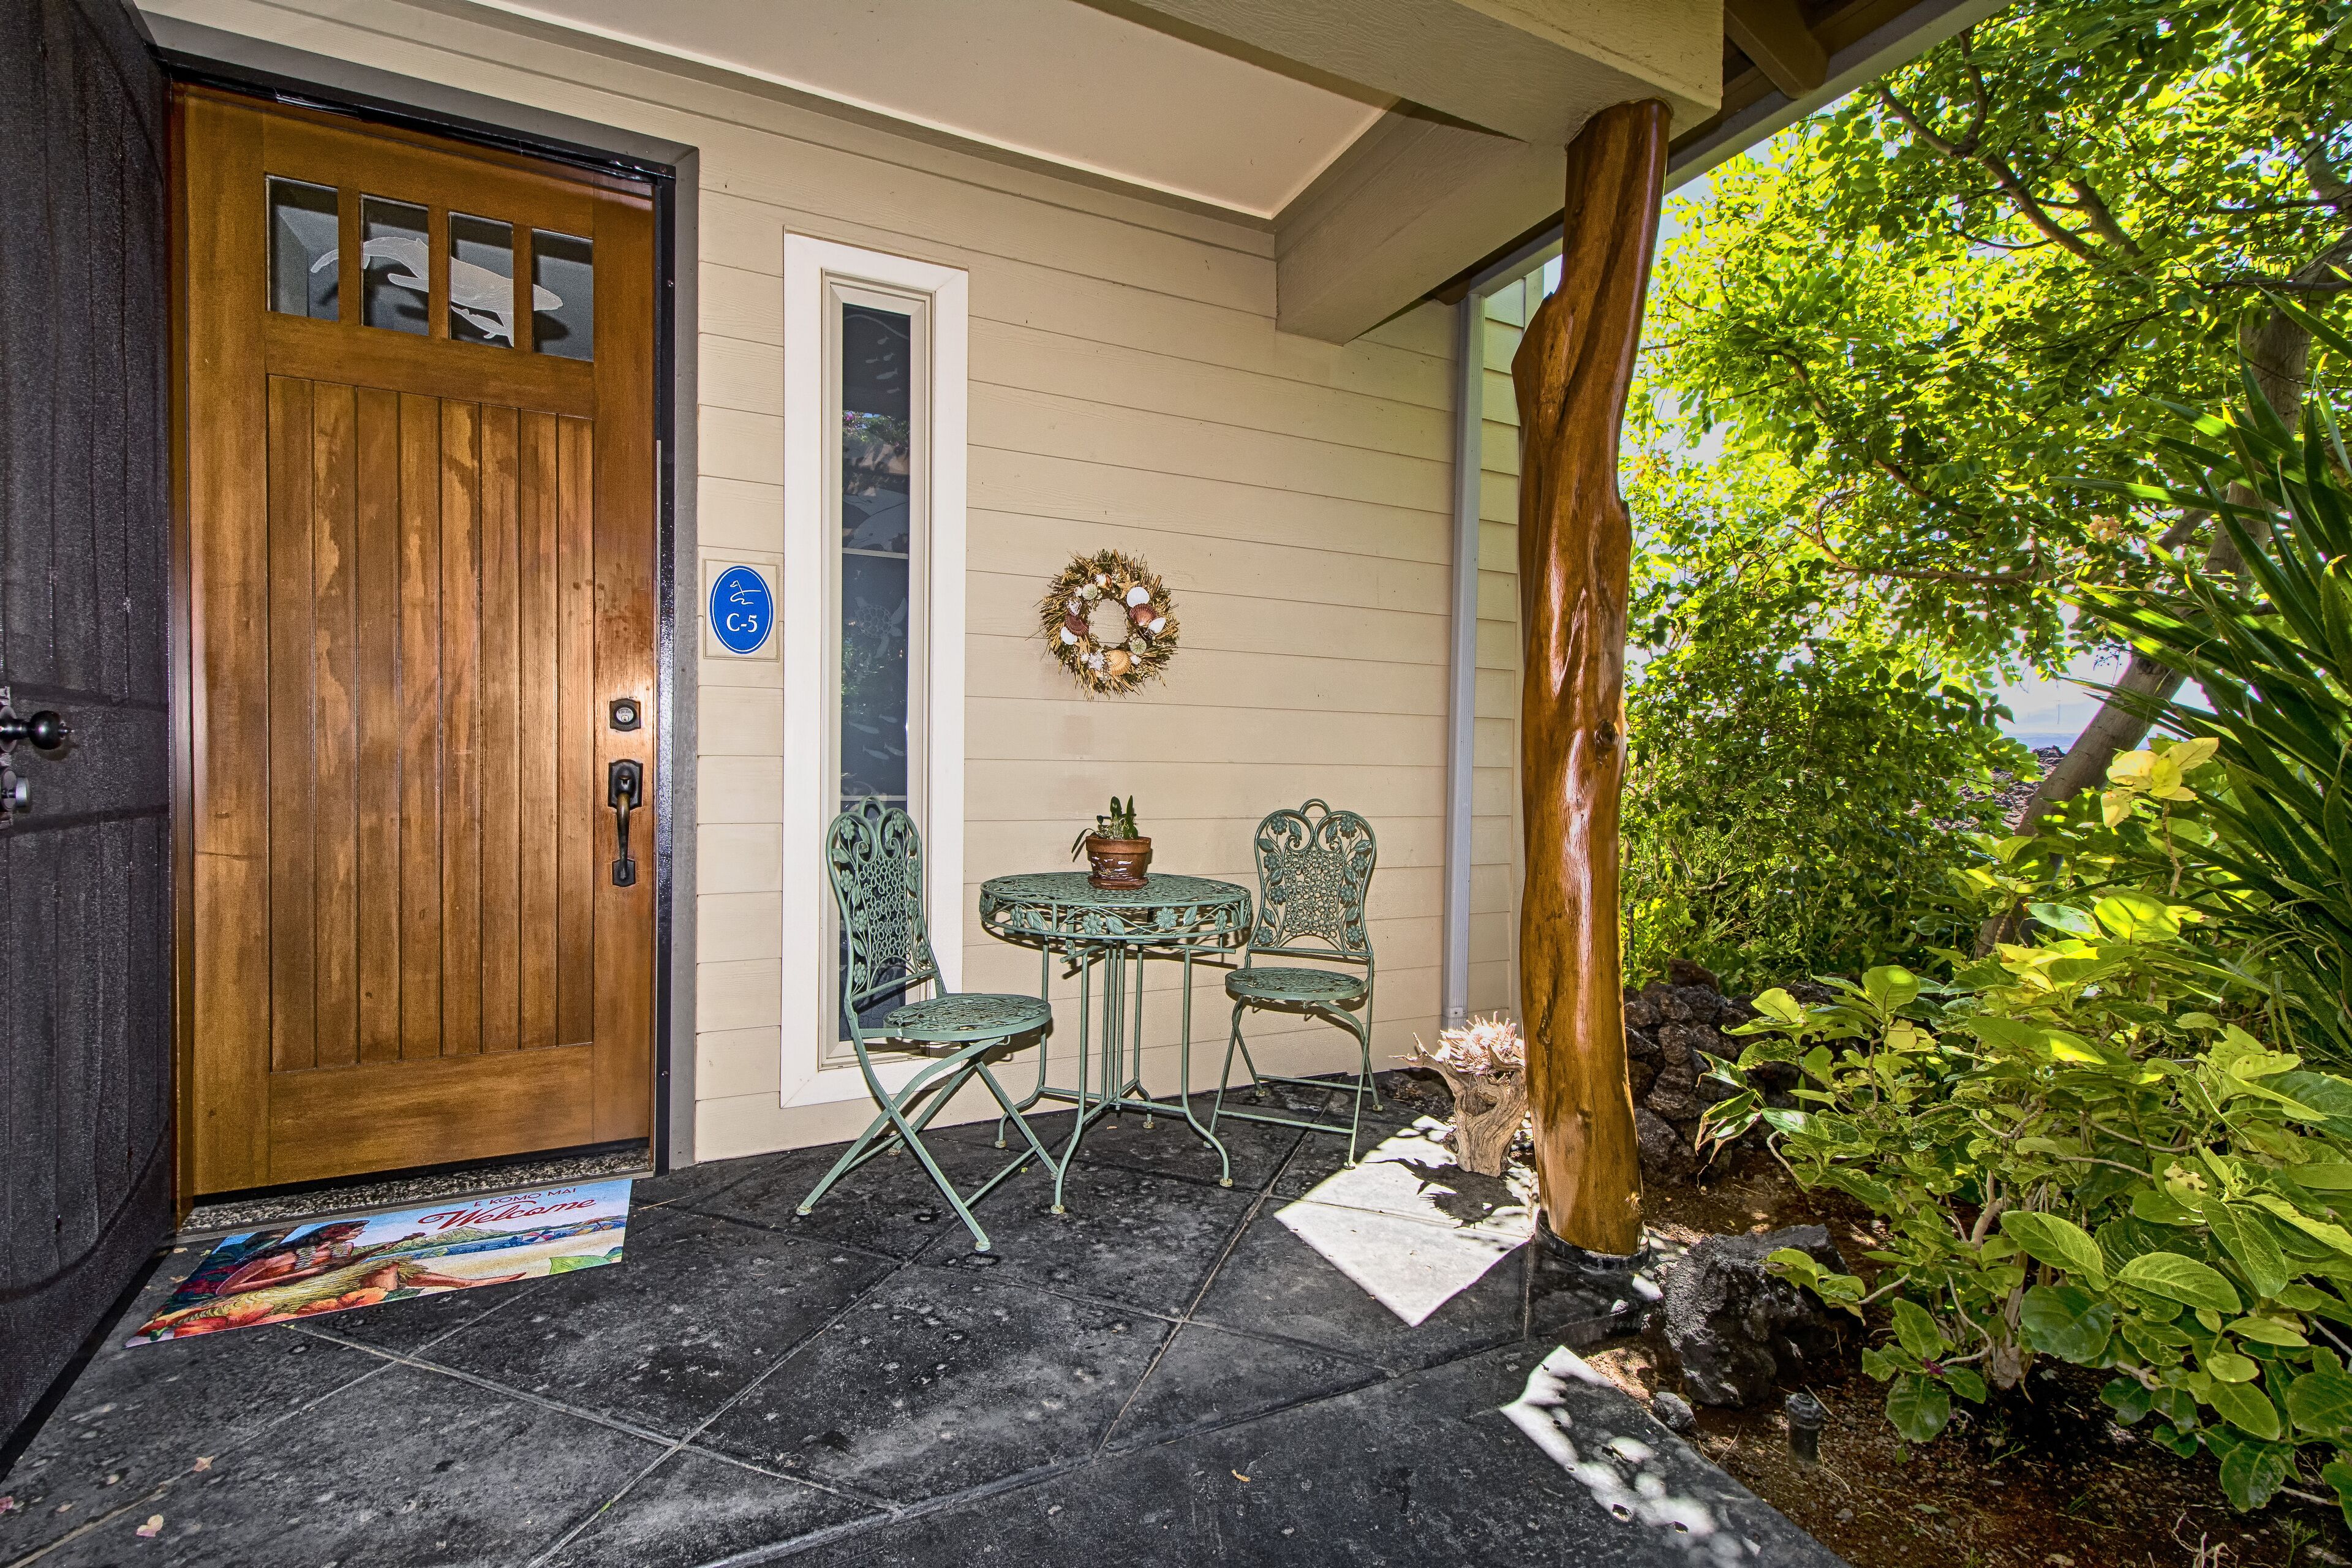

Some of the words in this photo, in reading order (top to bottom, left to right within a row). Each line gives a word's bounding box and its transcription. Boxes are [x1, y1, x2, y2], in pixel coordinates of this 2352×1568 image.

[726, 613, 758, 633] C-5
[489, 1193, 541, 1205] KOMO
[548, 1188, 576, 1196] MAI
[418, 1199, 597, 1230] Welcome
